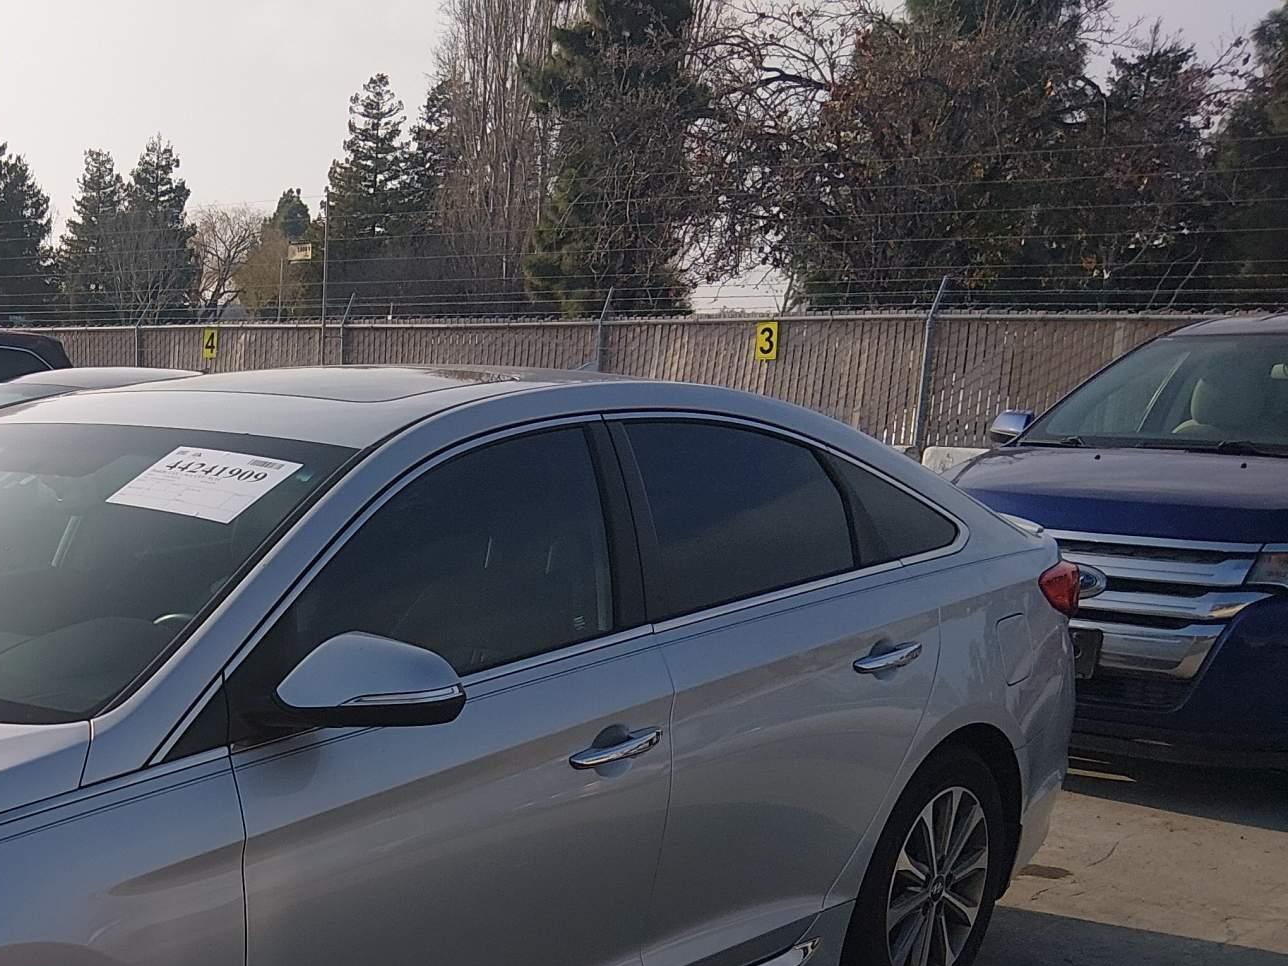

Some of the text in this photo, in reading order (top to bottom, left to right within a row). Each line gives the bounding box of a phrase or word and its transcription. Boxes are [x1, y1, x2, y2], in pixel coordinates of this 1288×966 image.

[204, 332, 216, 354] 4
[759, 327, 774, 355] 3
[165, 460, 268, 482] 44241909
